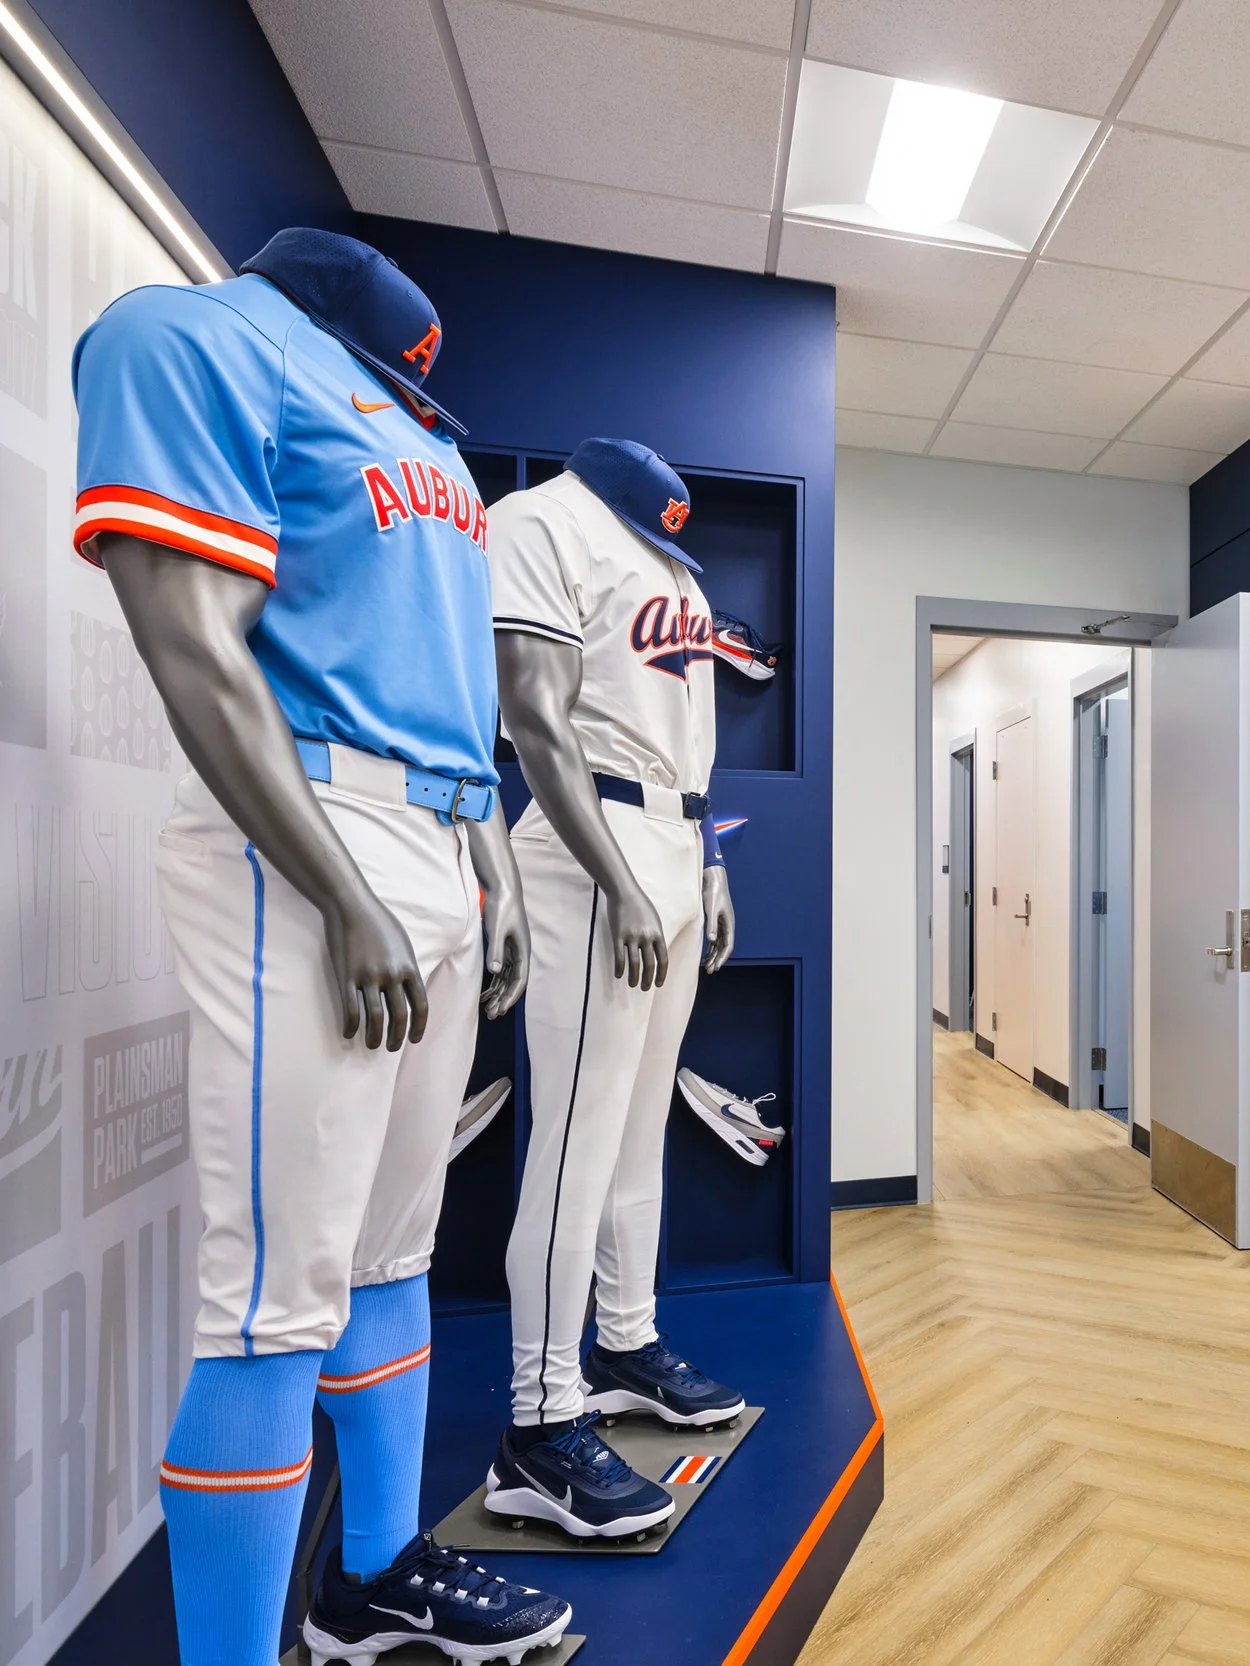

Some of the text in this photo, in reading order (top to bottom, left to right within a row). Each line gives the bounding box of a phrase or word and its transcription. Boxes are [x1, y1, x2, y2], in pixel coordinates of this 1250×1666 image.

[403, 323, 441, 375] A
[359, 457, 488, 559] AUBUR
[93, 1031, 184, 1120] PLAINSMAN
[93, 1111, 138, 1191] PARK
[141, 1103, 161, 1145] EST.
[0, 1203, 182, 1664] EBALL
